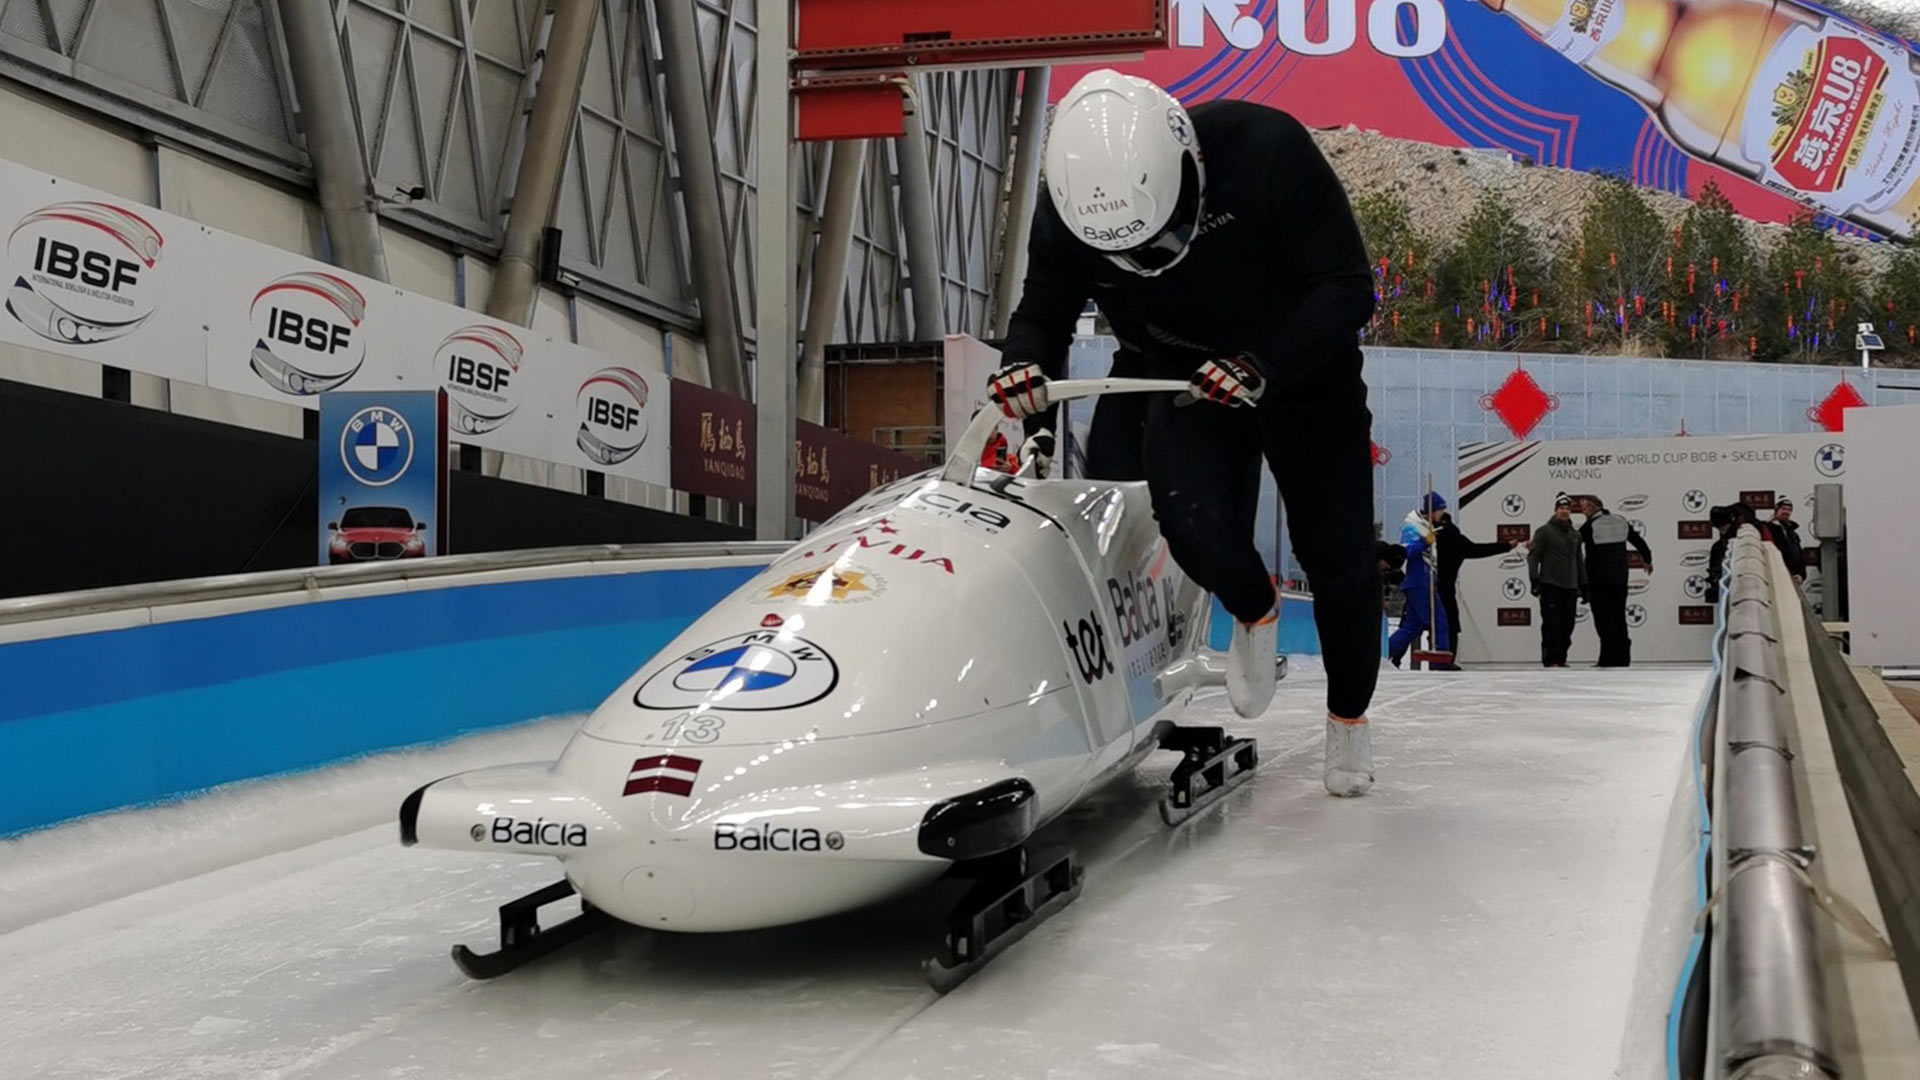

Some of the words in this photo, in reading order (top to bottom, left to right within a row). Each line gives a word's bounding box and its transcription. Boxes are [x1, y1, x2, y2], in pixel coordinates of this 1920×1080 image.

[1793, 55, 1861, 172] 燕京U8
[1823, 112, 1854, 167] YANJING
[1083, 218, 1146, 242] Balcia
[33, 236, 140, 292] IBSF
[267, 306, 352, 355] IBSF
[449, 354, 510, 393] IBSF
[351, 410, 404, 433] BMW
[587, 396, 640, 432] IBSF
[1547, 456, 1579, 467] BMW
[1584, 454, 1613, 466] IBSF
[1616, 453, 1661, 465] WORLD
[1663, 452, 1689, 464] CUP
[1690, 451, 1718, 463] BOB
[1731, 450, 1797, 462] SKELETON
[1548, 468, 1603, 480] YANQING
[1106, 569, 1161, 648] Balcia
[1062, 609, 1115, 685] tet
[660, 711, 726, 745] 13
[491, 816, 588, 848] Balcia
[713, 822, 822, 852] Balcia
